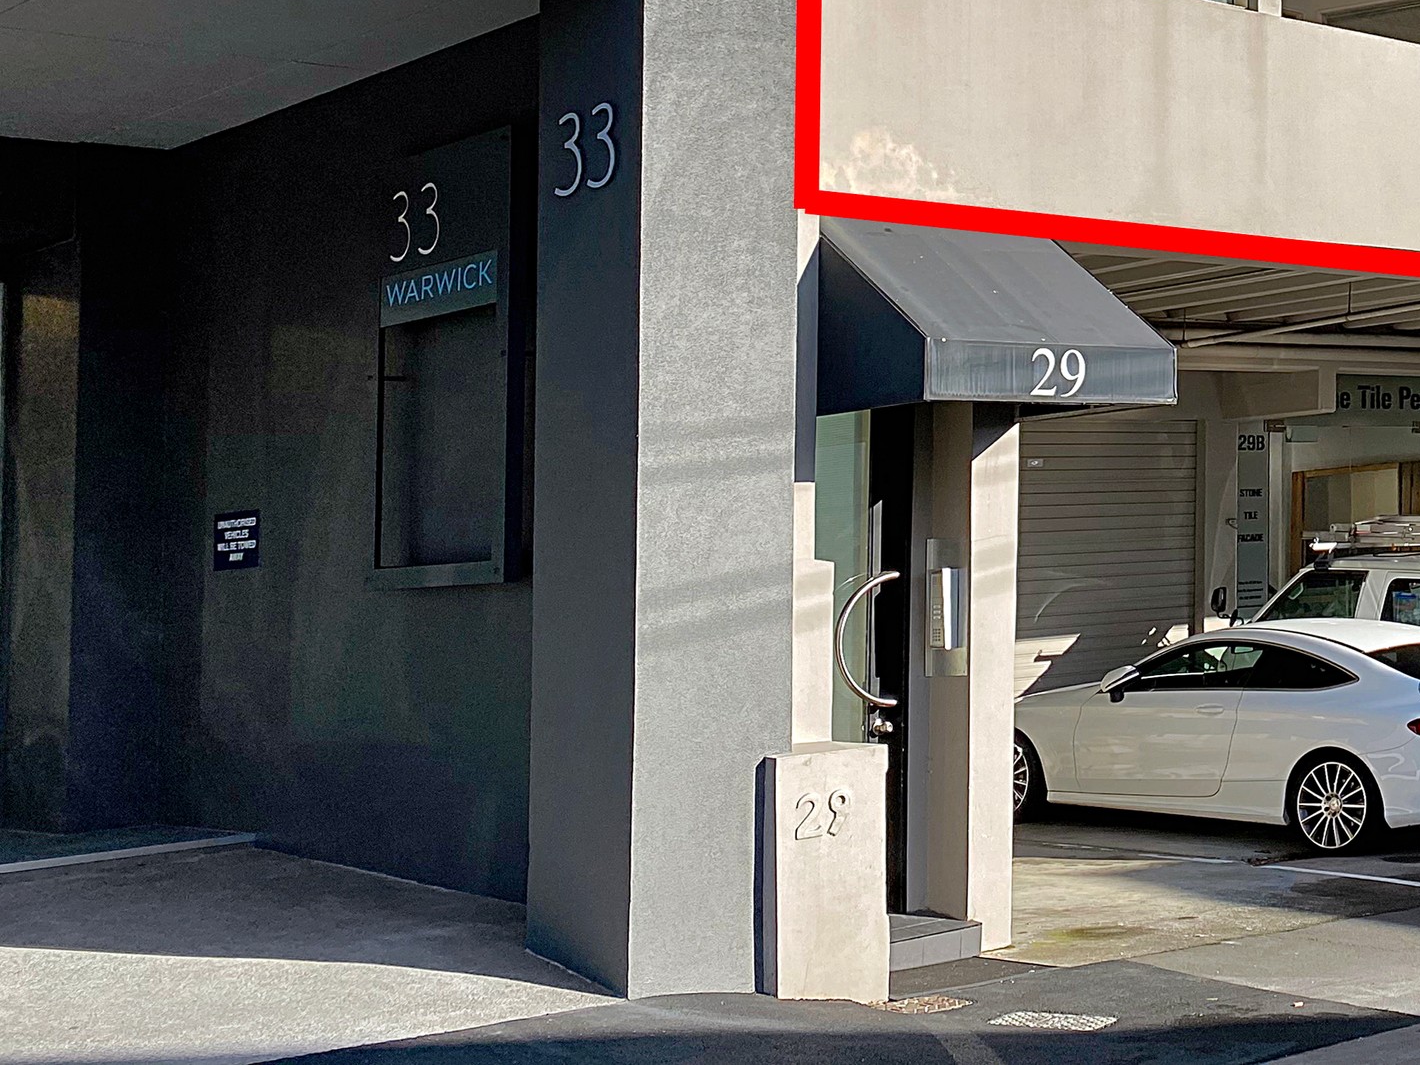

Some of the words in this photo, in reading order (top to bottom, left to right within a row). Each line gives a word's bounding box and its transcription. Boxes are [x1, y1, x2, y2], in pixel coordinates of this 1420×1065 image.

[554, 102, 616, 197] 33
[389, 182, 440, 263] 33
[385, 259, 493, 308] WARWICK
[1029, 347, 1087, 398] 29
[1357, 385, 1392, 410] Tile
[1238, 434, 1266, 451] 29B
[1243, 511, 1258, 520] TILE
[795, 789, 851, 840] 29
